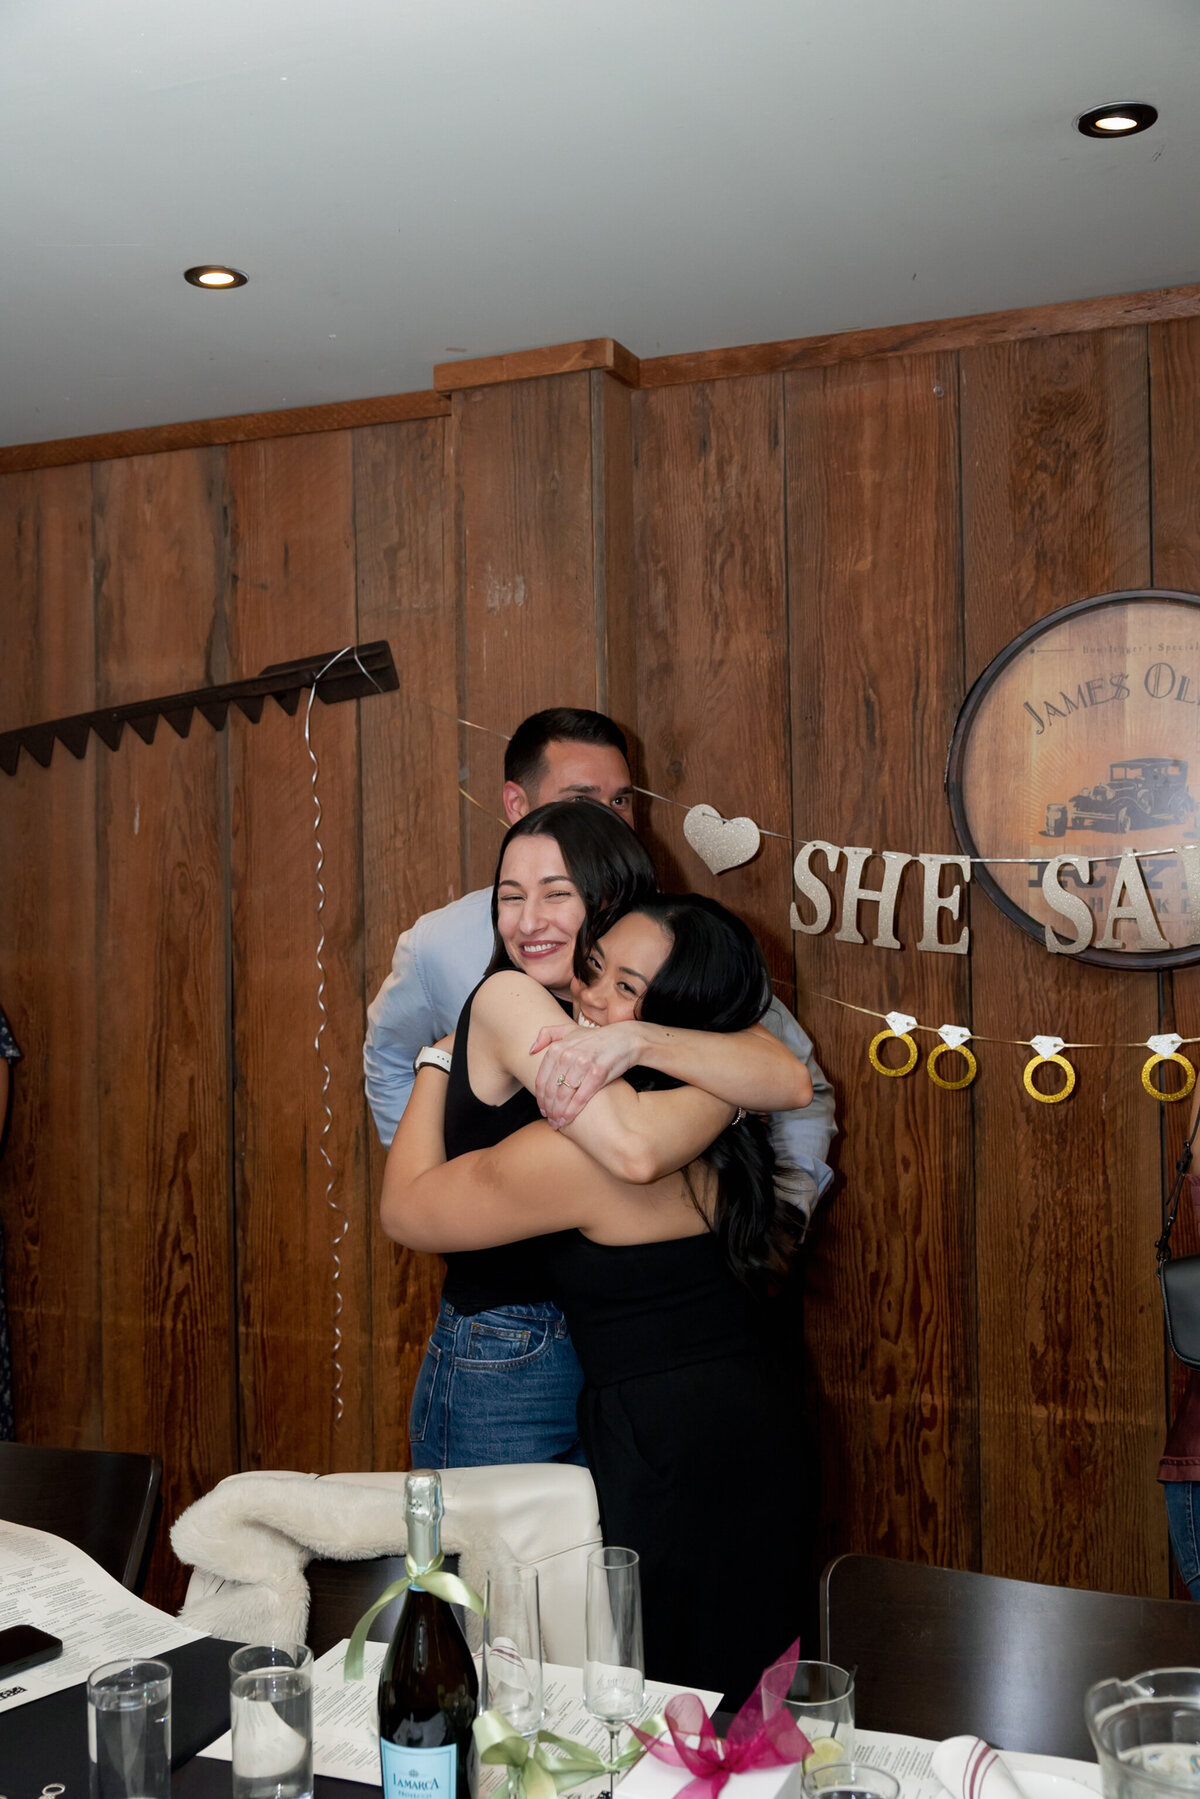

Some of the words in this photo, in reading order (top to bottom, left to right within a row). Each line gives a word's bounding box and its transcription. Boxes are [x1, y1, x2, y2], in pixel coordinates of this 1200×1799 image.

[1023, 672, 1131, 735] JAMES
[1143, 662, 1200, 706] OL
[789, 840, 971, 955] SHE
